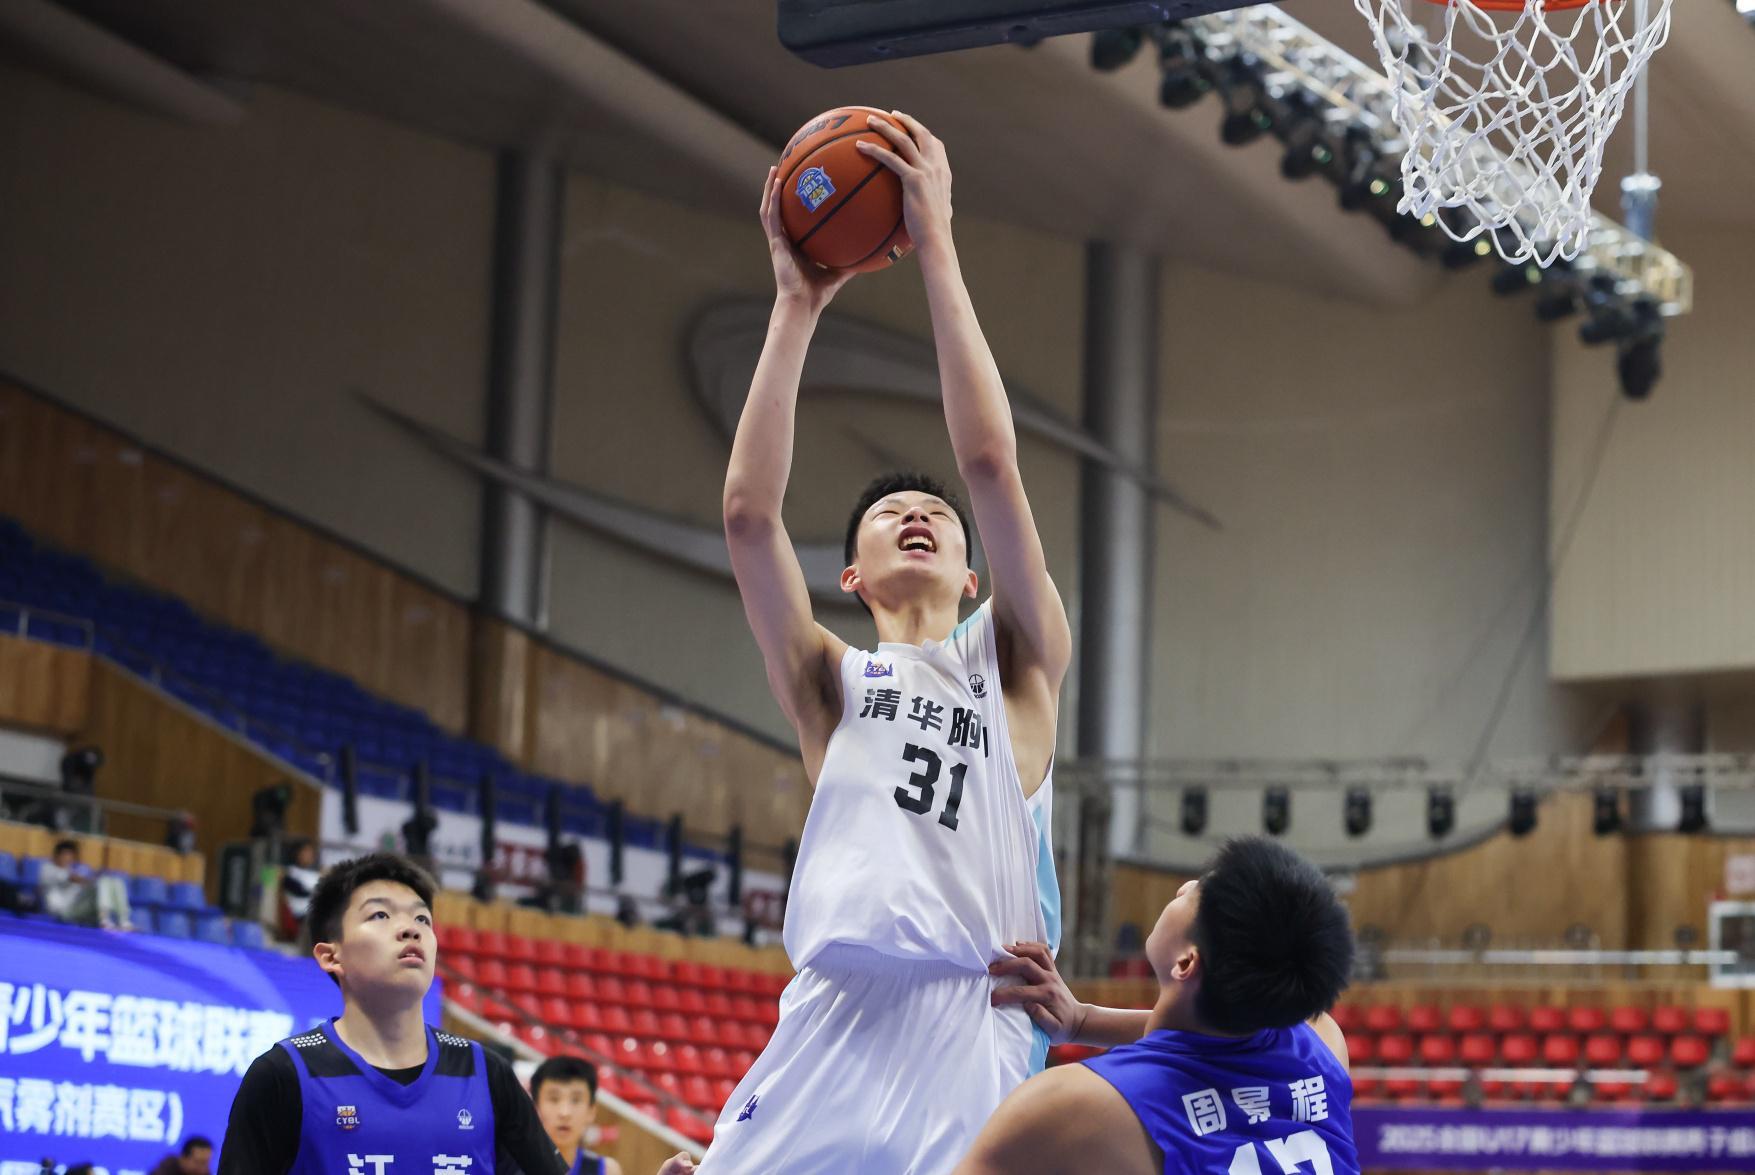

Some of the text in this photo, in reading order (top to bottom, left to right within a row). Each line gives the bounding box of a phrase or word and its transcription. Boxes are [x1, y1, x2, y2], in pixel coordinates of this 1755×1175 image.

[859, 688, 988, 758] 清华附
[894, 743, 968, 832] 31
[336, 1116, 360, 1125] CYBL
[1182, 1075, 1329, 1136] 周景程
